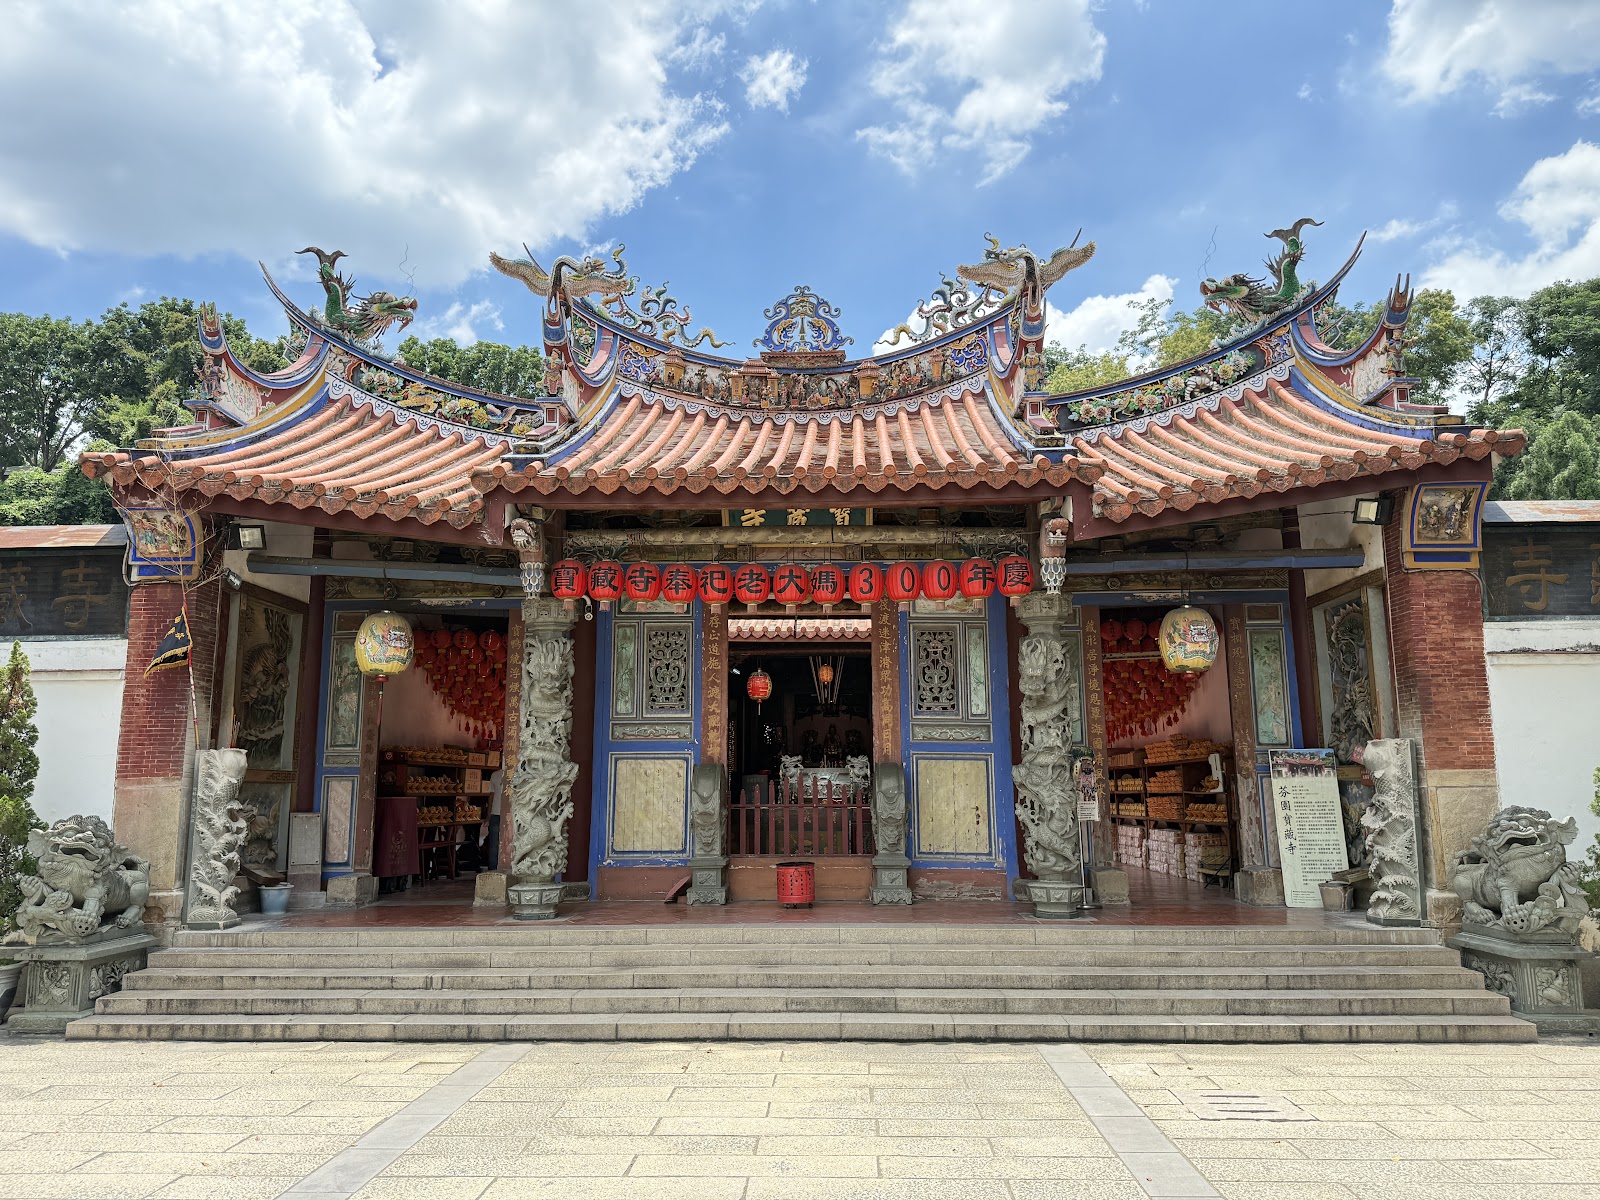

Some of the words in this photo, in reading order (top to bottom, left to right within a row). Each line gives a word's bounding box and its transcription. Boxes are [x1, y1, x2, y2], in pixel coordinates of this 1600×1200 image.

[1278, 785, 1297, 855] 芬園寶藏寺
